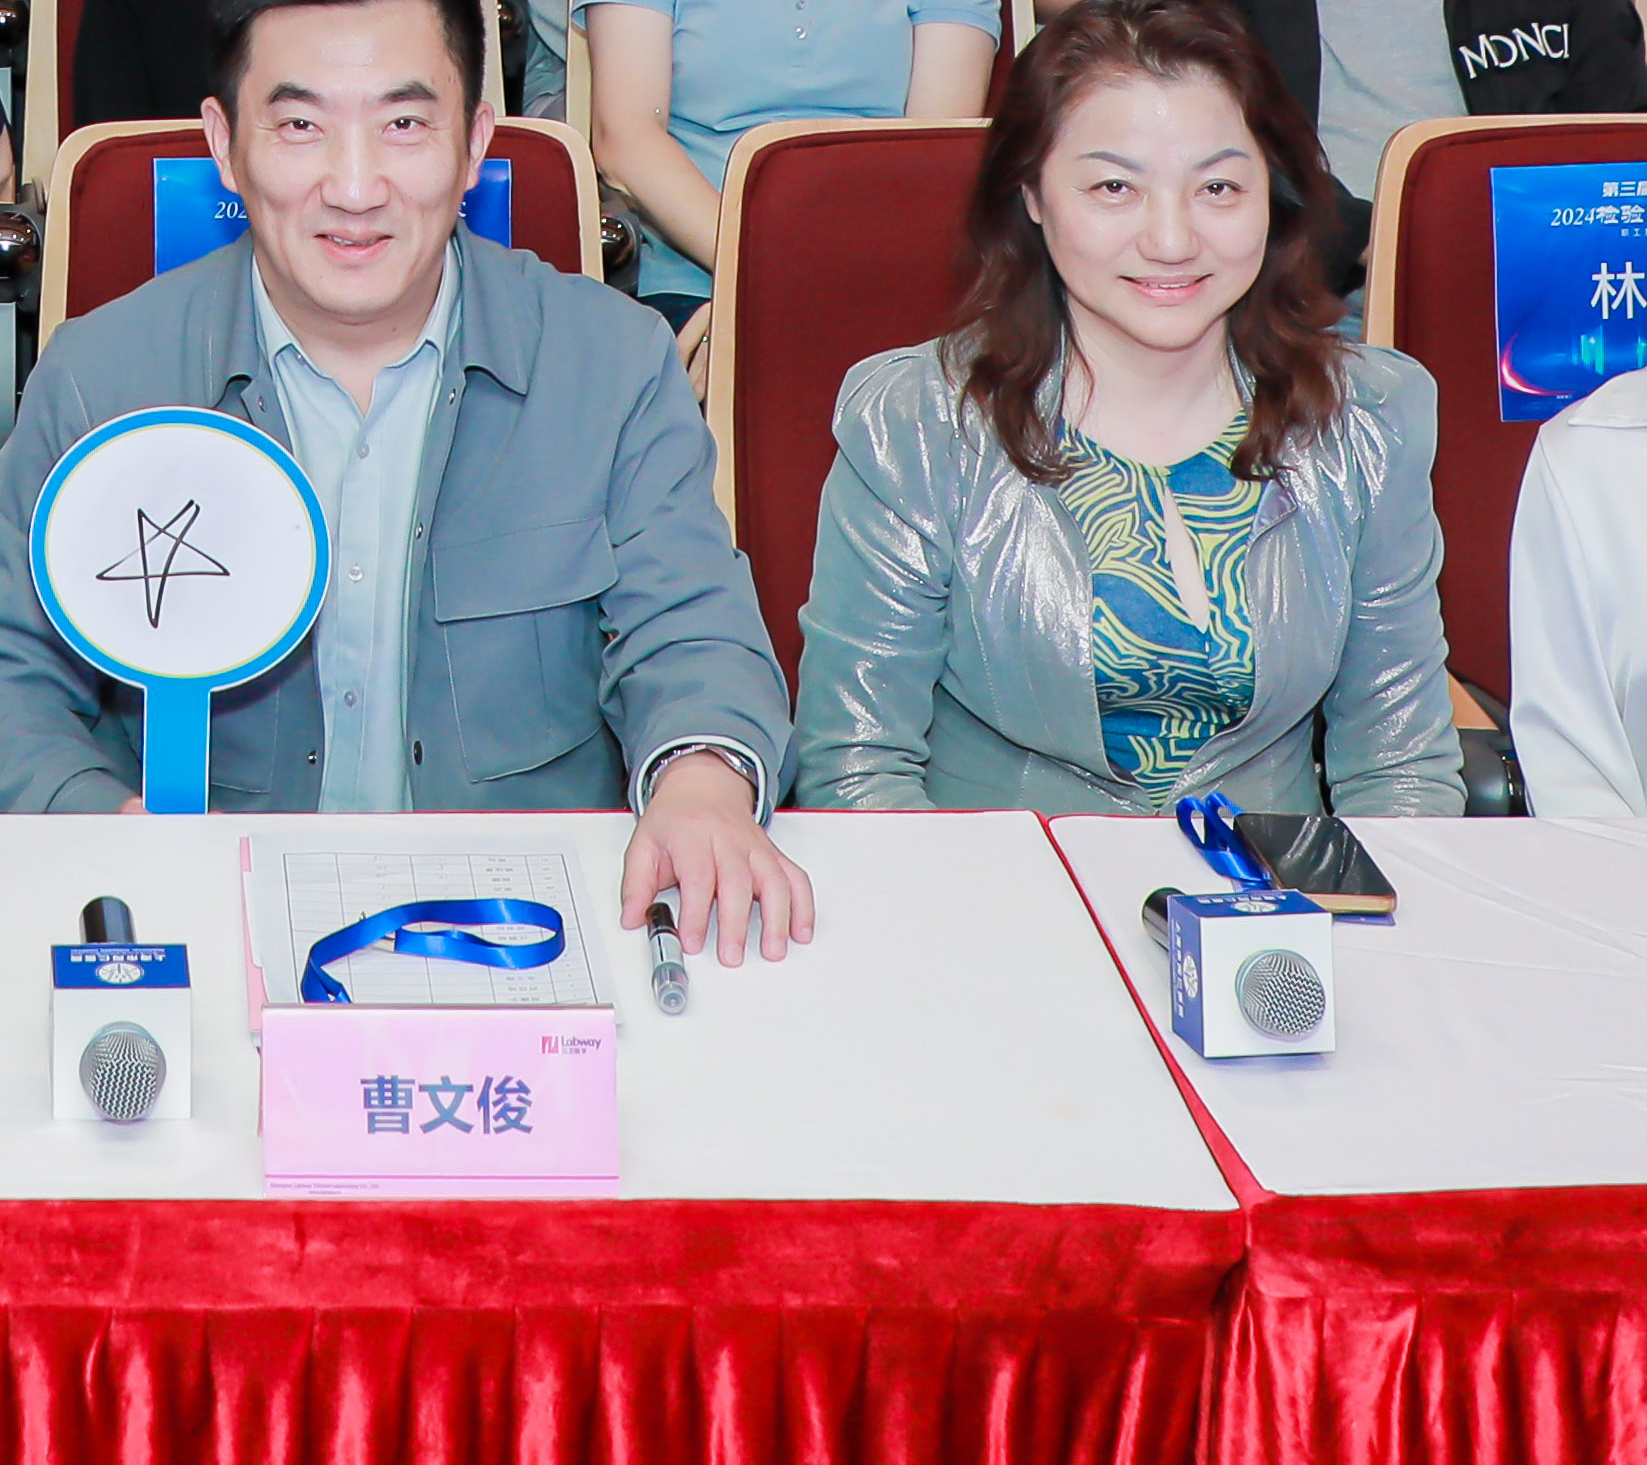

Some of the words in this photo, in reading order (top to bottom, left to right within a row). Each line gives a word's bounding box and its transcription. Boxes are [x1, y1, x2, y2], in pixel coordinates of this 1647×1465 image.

[561, 1036, 602, 1050] Labway
[360, 1074, 534, 1135] 曹文俊
